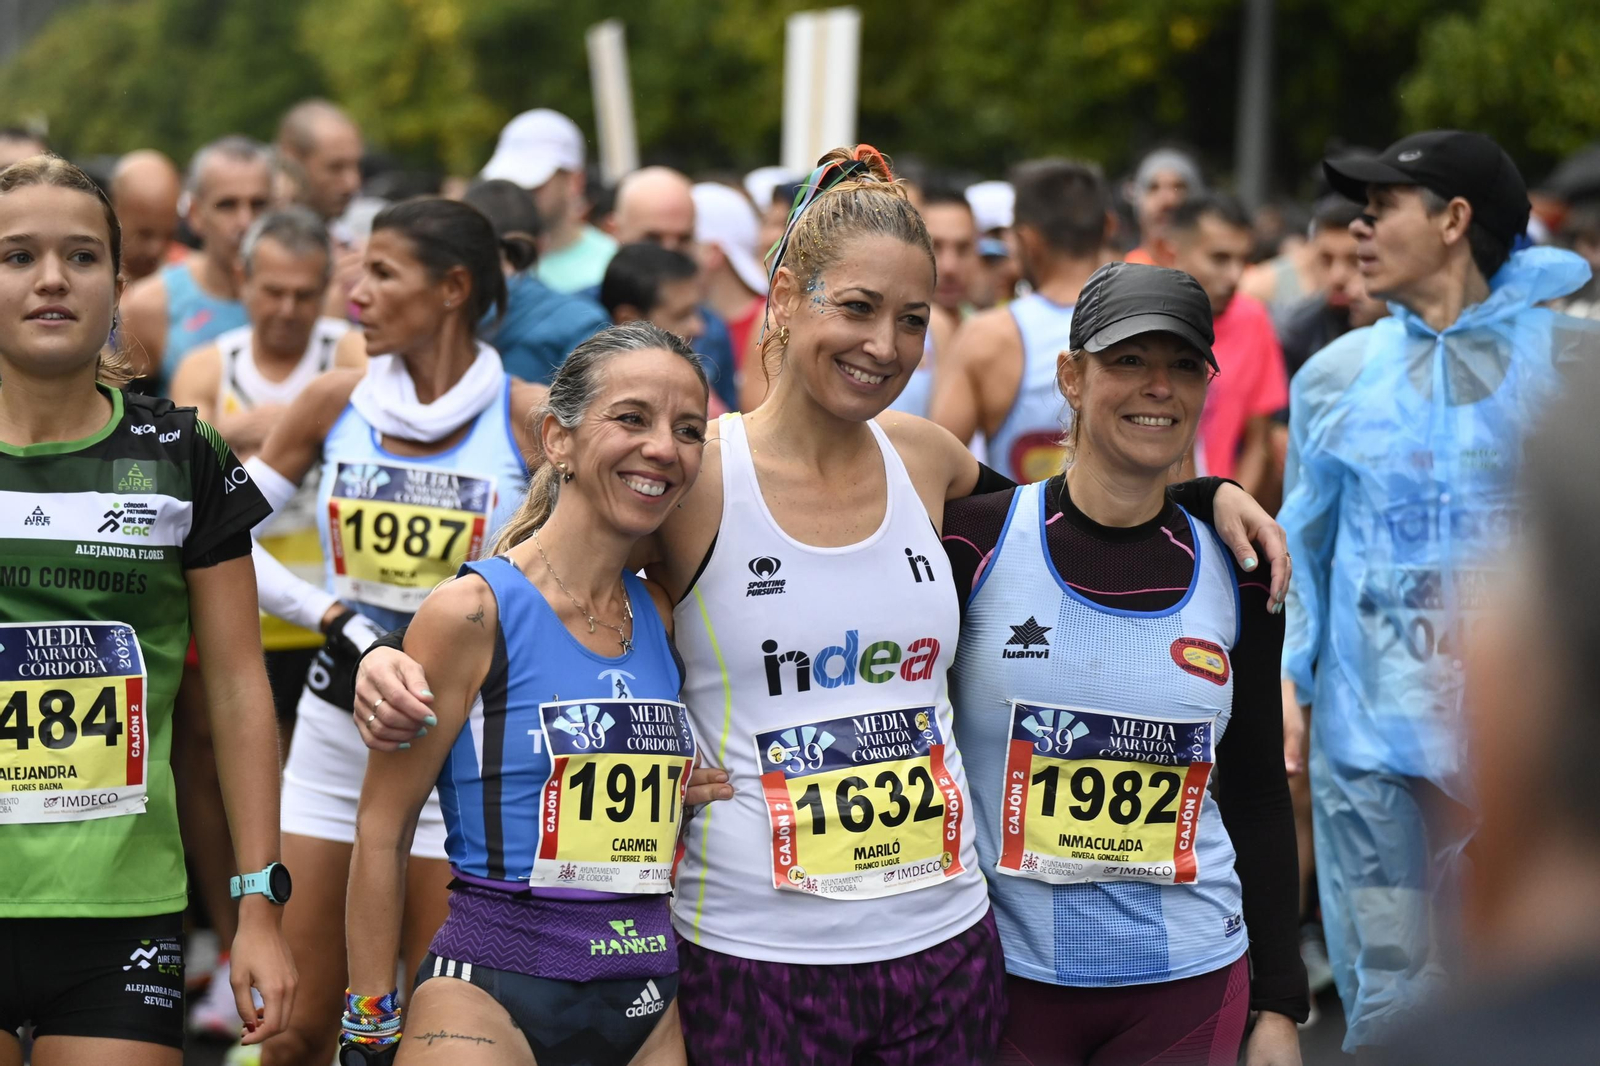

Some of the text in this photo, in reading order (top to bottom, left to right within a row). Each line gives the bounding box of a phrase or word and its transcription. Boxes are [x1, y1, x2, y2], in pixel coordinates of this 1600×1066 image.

[123, 526, 149, 536] CAC
[346, 509, 467, 562] 1987
[75, 544, 164, 560] ALEJANDRA FLORES
[904, 547, 935, 583] in
[39, 567, 148, 594] CORDOBÉS
[747, 579, 786, 589] SPORTING
[746, 587, 786, 597] PURSUITS.
[26, 628, 96, 647] MEDIA
[26, 646, 98, 661] MARATÓN
[762, 630, 940, 696] indea
[1002, 649, 1050, 659] luanvi
[18, 660, 108, 677] CÓRDOBA
[0, 686, 123, 750] 484
[629, 705, 675, 724] MEDIA
[852, 711, 909, 735] MEDIA
[132, 715, 141, 758] CAJÓN
[569, 722, 607, 750] 39
[632, 722, 677, 737] MARATÓN
[856, 728, 912, 748] MARATÓN
[1111, 718, 1176, 741] MEDIA
[627, 735, 681, 752] CÓRDOBA
[1034, 725, 1074, 755] 39
[1109, 736, 1176, 753] MARATÓN
[1192, 726, 1204, 762] 2025
[783, 743, 824, 774] 39
[851, 743, 919, 763] CÓRDOBA
[0, 765, 78, 780] ALEJANDRA
[62, 793, 118, 807] IMDECO
[569, 762, 683, 823] 1917
[796, 766, 944, 836] 1632
[1032, 766, 1182, 825] 1982
[547, 779, 558, 833] CAJÓN 2
[940, 777, 959, 841] CAJÓN 2
[1009, 771, 1024, 835] CAJÓN 2
[1180, 786, 1199, 850] CAJÓN 2
[775, 803, 791, 866] CAJÓN 2
[1058, 834, 1143, 852] INMACULADA
[612, 838, 657, 852] CARMEN
[854, 838, 900, 860] MARILÓ
[855, 857, 900, 870] FRANCO LUQUE
[1041, 859, 1083, 870] AYUNTAMIENTO
[1072, 852, 1095, 860] RIVERA
[579, 866, 620, 875] AYUNTAMIENTO
[897, 860, 941, 880] IMDECO
[1119, 866, 1173, 876] IMDECO
[820, 875, 863, 886] AYUNTAMIENTO
[590, 934, 668, 956] HANKER
[158, 955, 170, 964] AIRE
[125, 984, 167, 994] ALEJANDRA
[144, 996, 173, 1008] SEVILLA
[626, 998, 664, 1018] adidas
